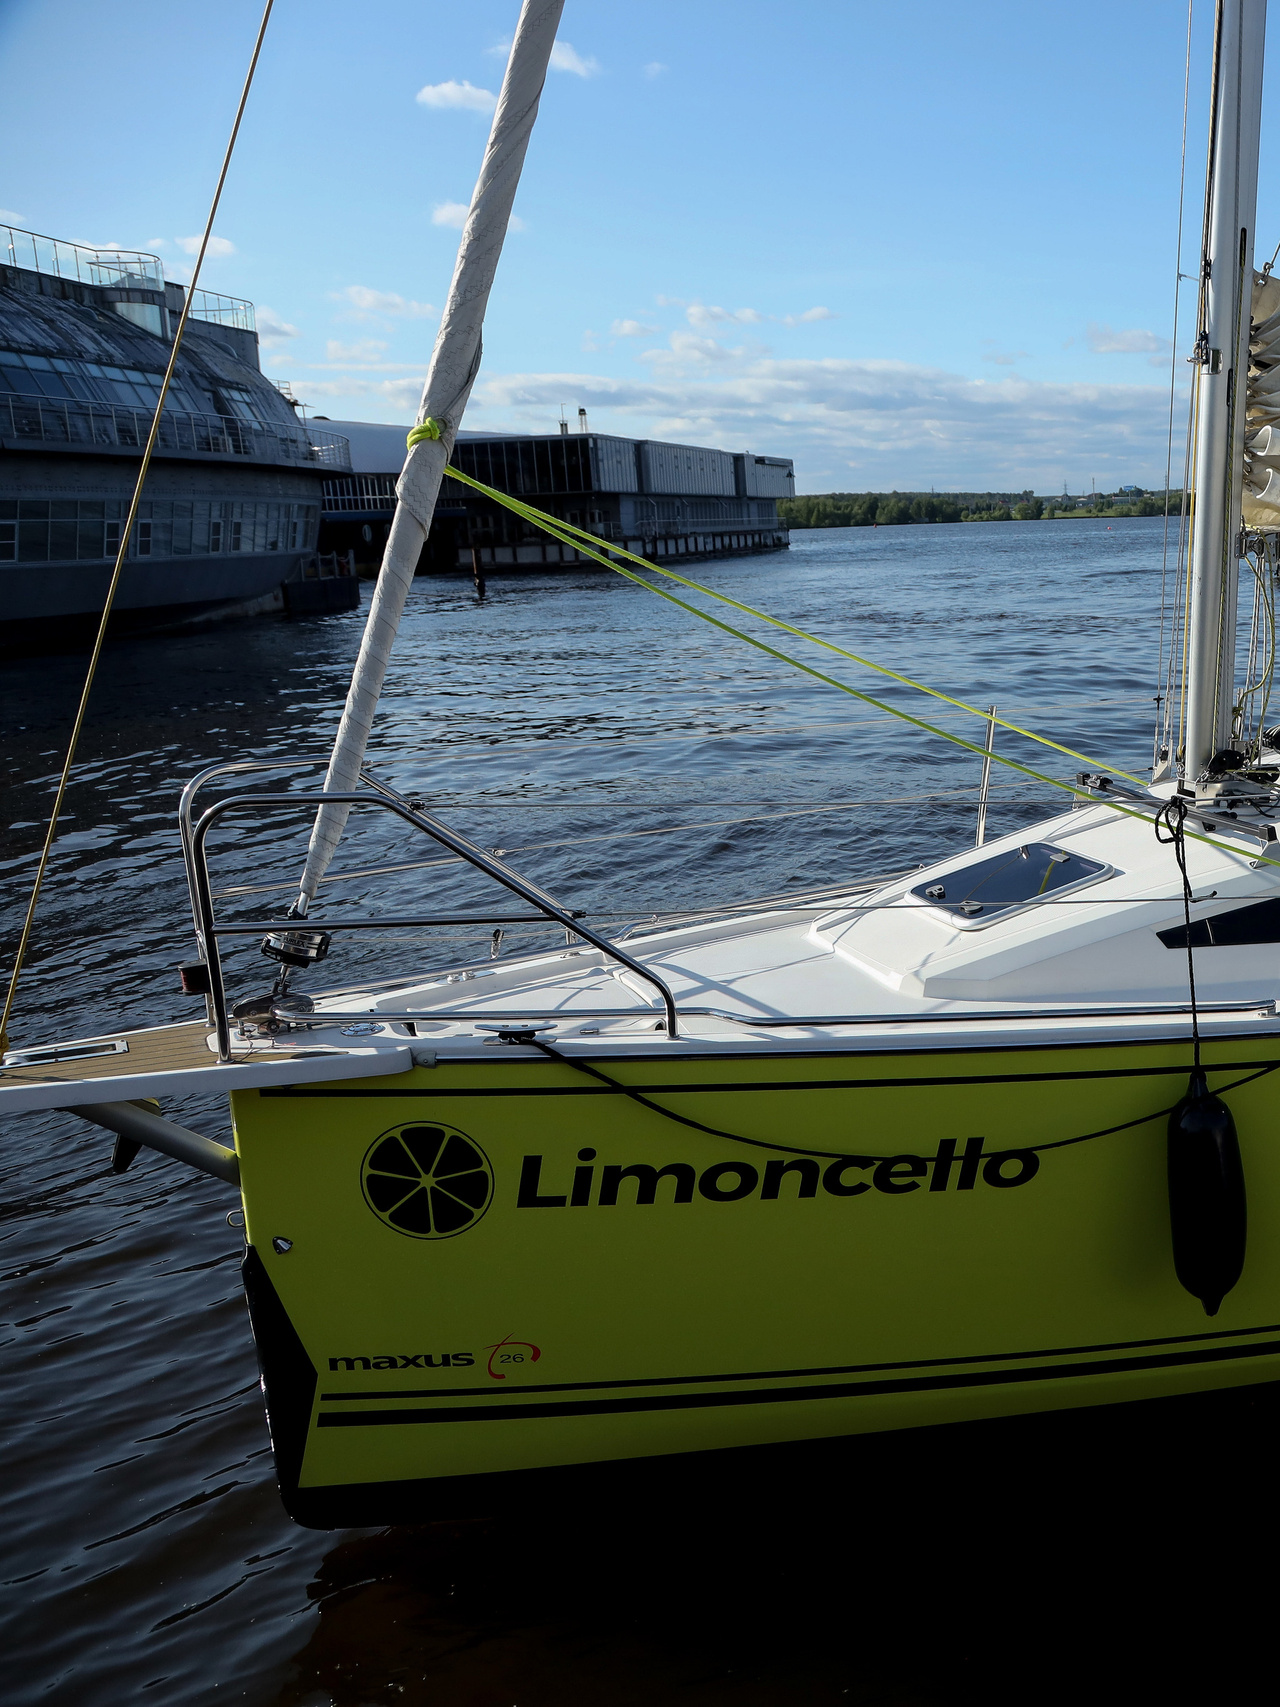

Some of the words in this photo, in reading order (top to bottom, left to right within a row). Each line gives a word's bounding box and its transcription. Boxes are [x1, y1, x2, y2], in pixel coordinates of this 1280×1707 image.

[516, 1137, 1040, 1209] Limoncello
[328, 1353, 475, 1371] maxus
[500, 1353, 524, 1364] 26
